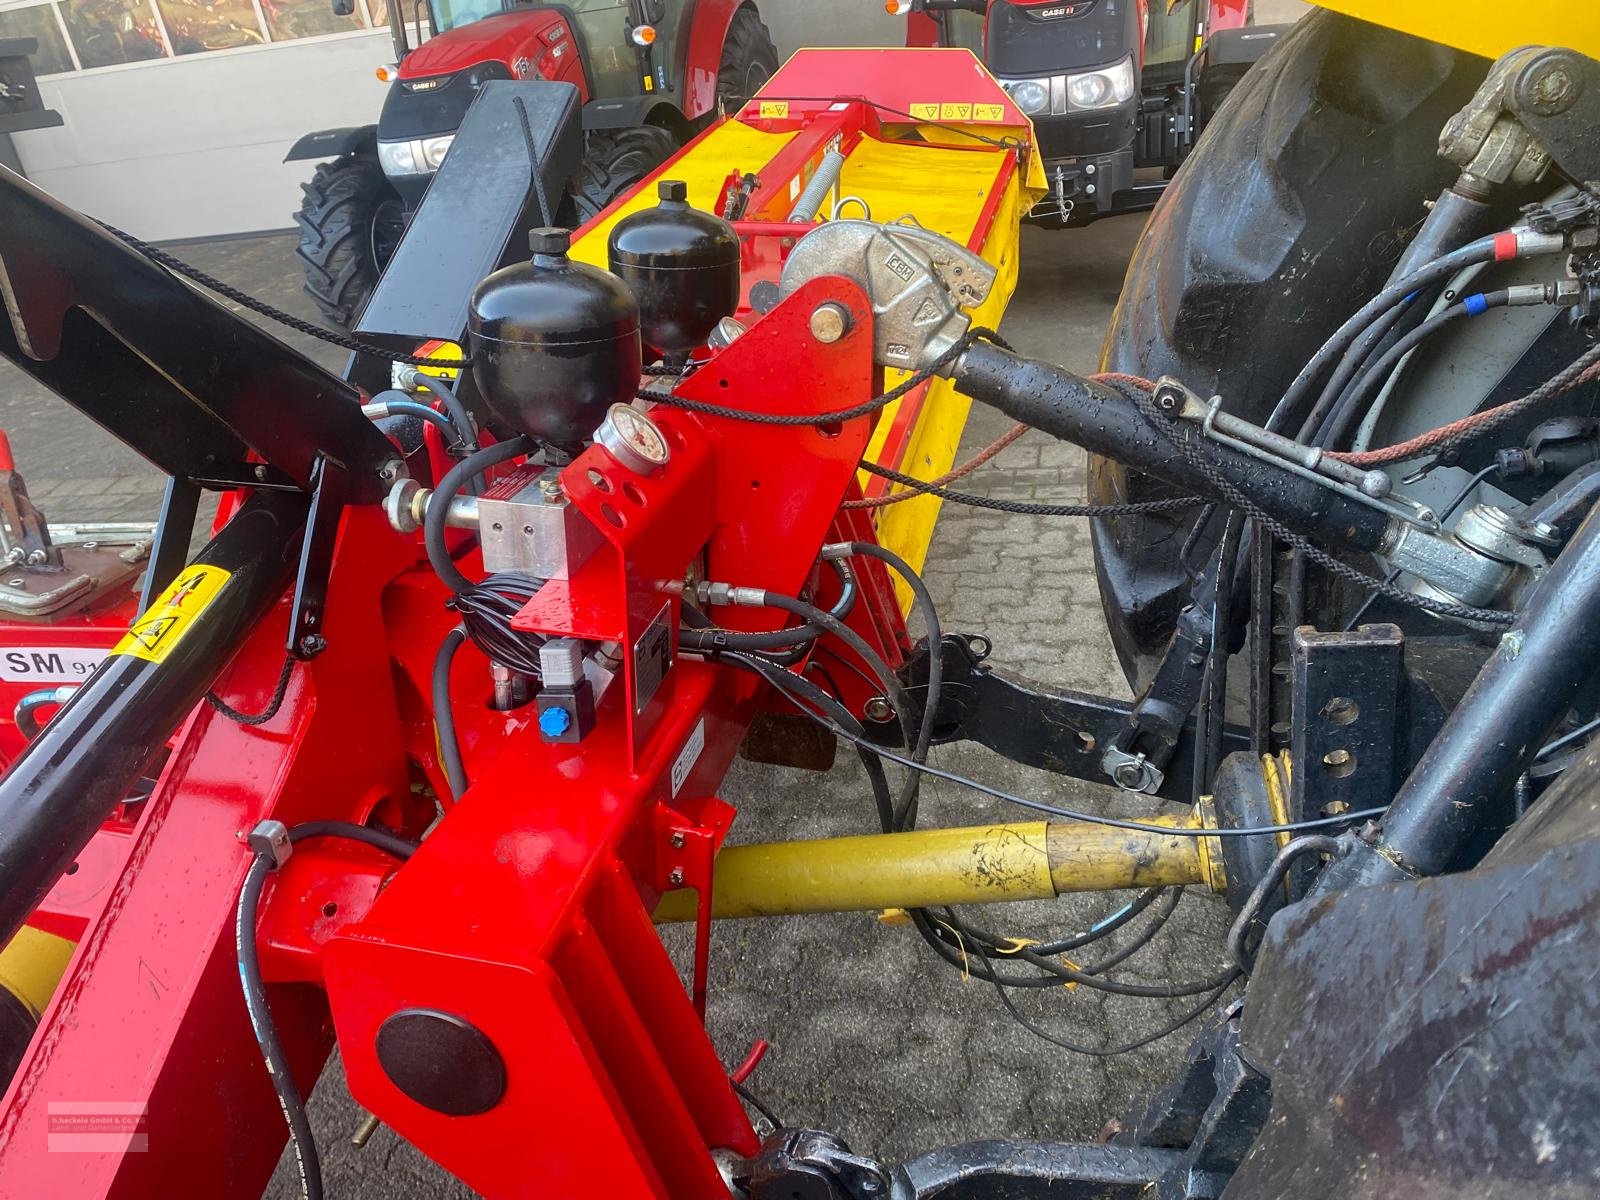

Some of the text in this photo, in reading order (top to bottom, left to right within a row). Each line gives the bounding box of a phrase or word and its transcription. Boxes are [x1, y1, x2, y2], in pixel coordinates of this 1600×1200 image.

[1042, 9, 1065, 17] CASE
[889, 254, 914, 279] CBM
[6, 652, 65, 674] SM
